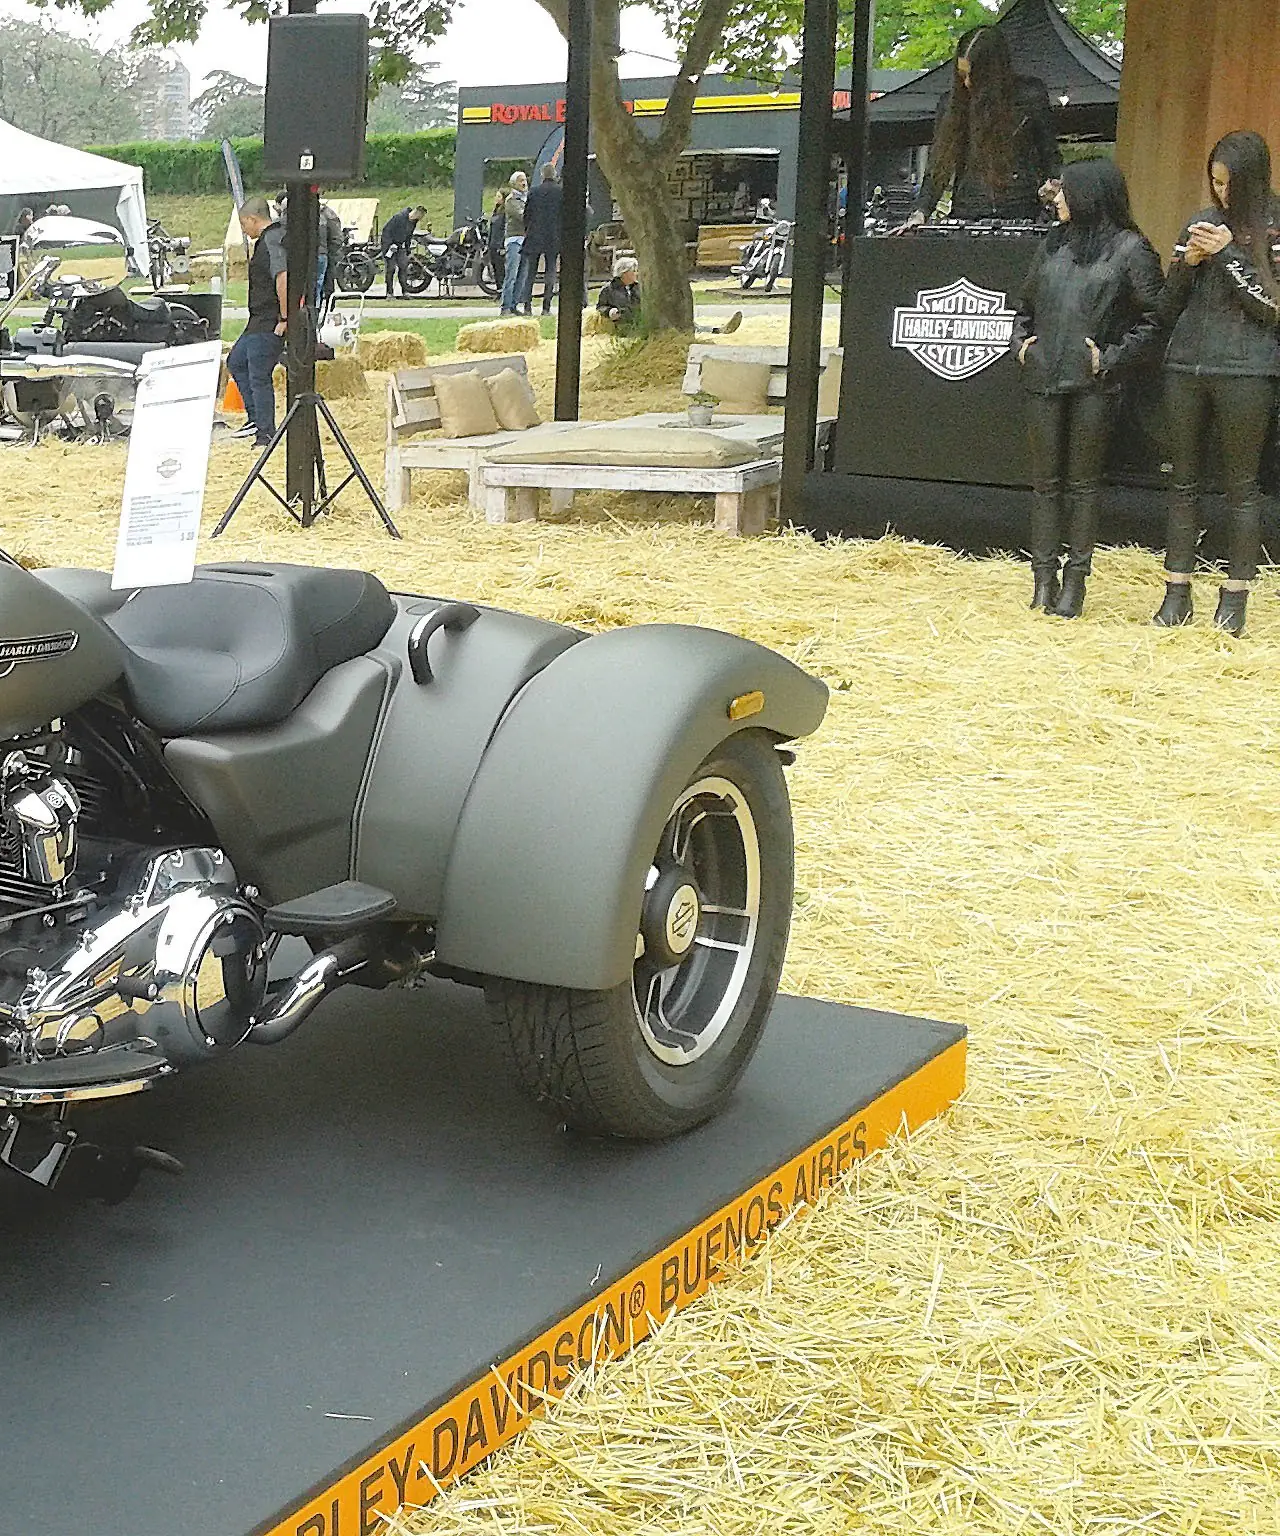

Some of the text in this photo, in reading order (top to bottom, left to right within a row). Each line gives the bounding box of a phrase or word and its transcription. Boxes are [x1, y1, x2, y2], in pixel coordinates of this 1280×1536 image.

[491, 103, 552, 125] ROYAL
[931, 295, 991, 314] MOTOR
[904, 318, 1014, 341] HARLEY-DAVIDSON
[928, 344, 986, 370] CYCLES
[660, 1181, 783, 1314] BUENOS
[792, 1121, 867, 1206] AIRES
